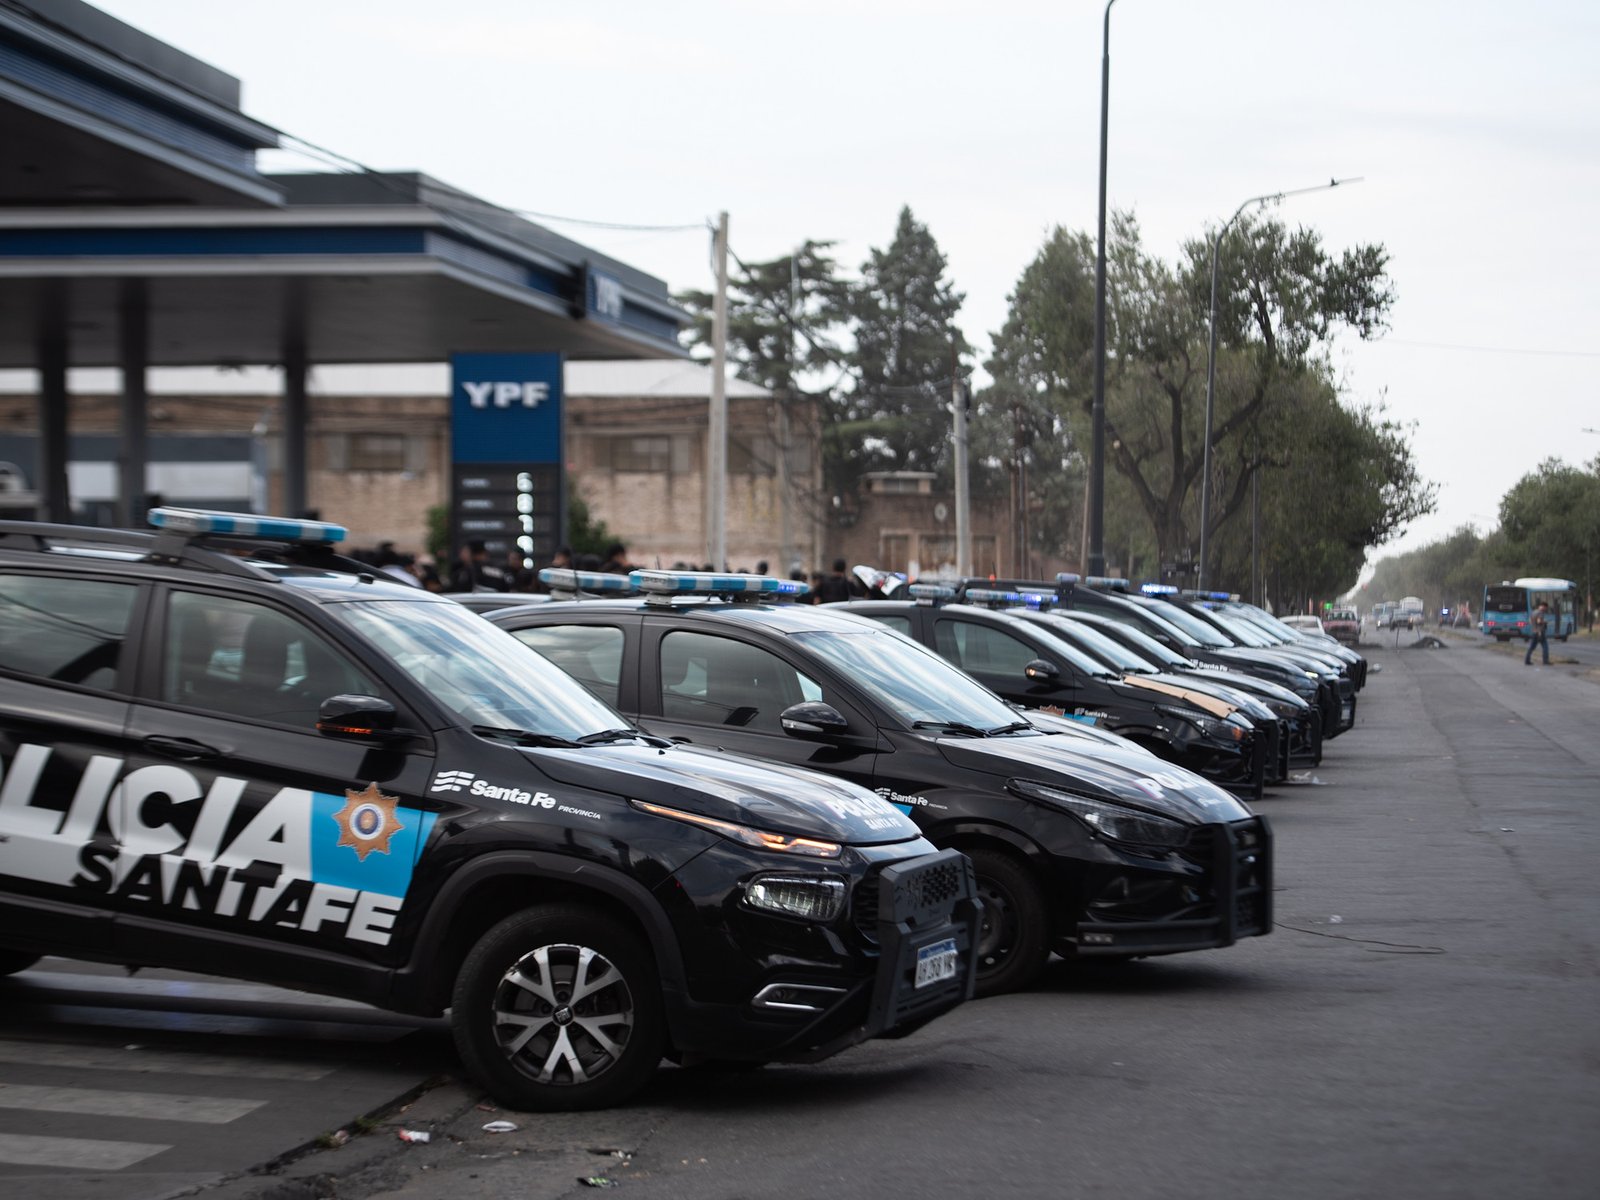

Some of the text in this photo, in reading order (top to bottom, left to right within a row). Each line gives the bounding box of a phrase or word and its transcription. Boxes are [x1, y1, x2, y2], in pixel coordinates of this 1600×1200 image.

[462, 381, 550, 408] YPF
[0, 743, 312, 876] LICIA
[470, 780, 601, 820] Santa Fe PROVINCIA
[890, 792, 917, 804] Santa
[917, 796, 928, 806] Fe
